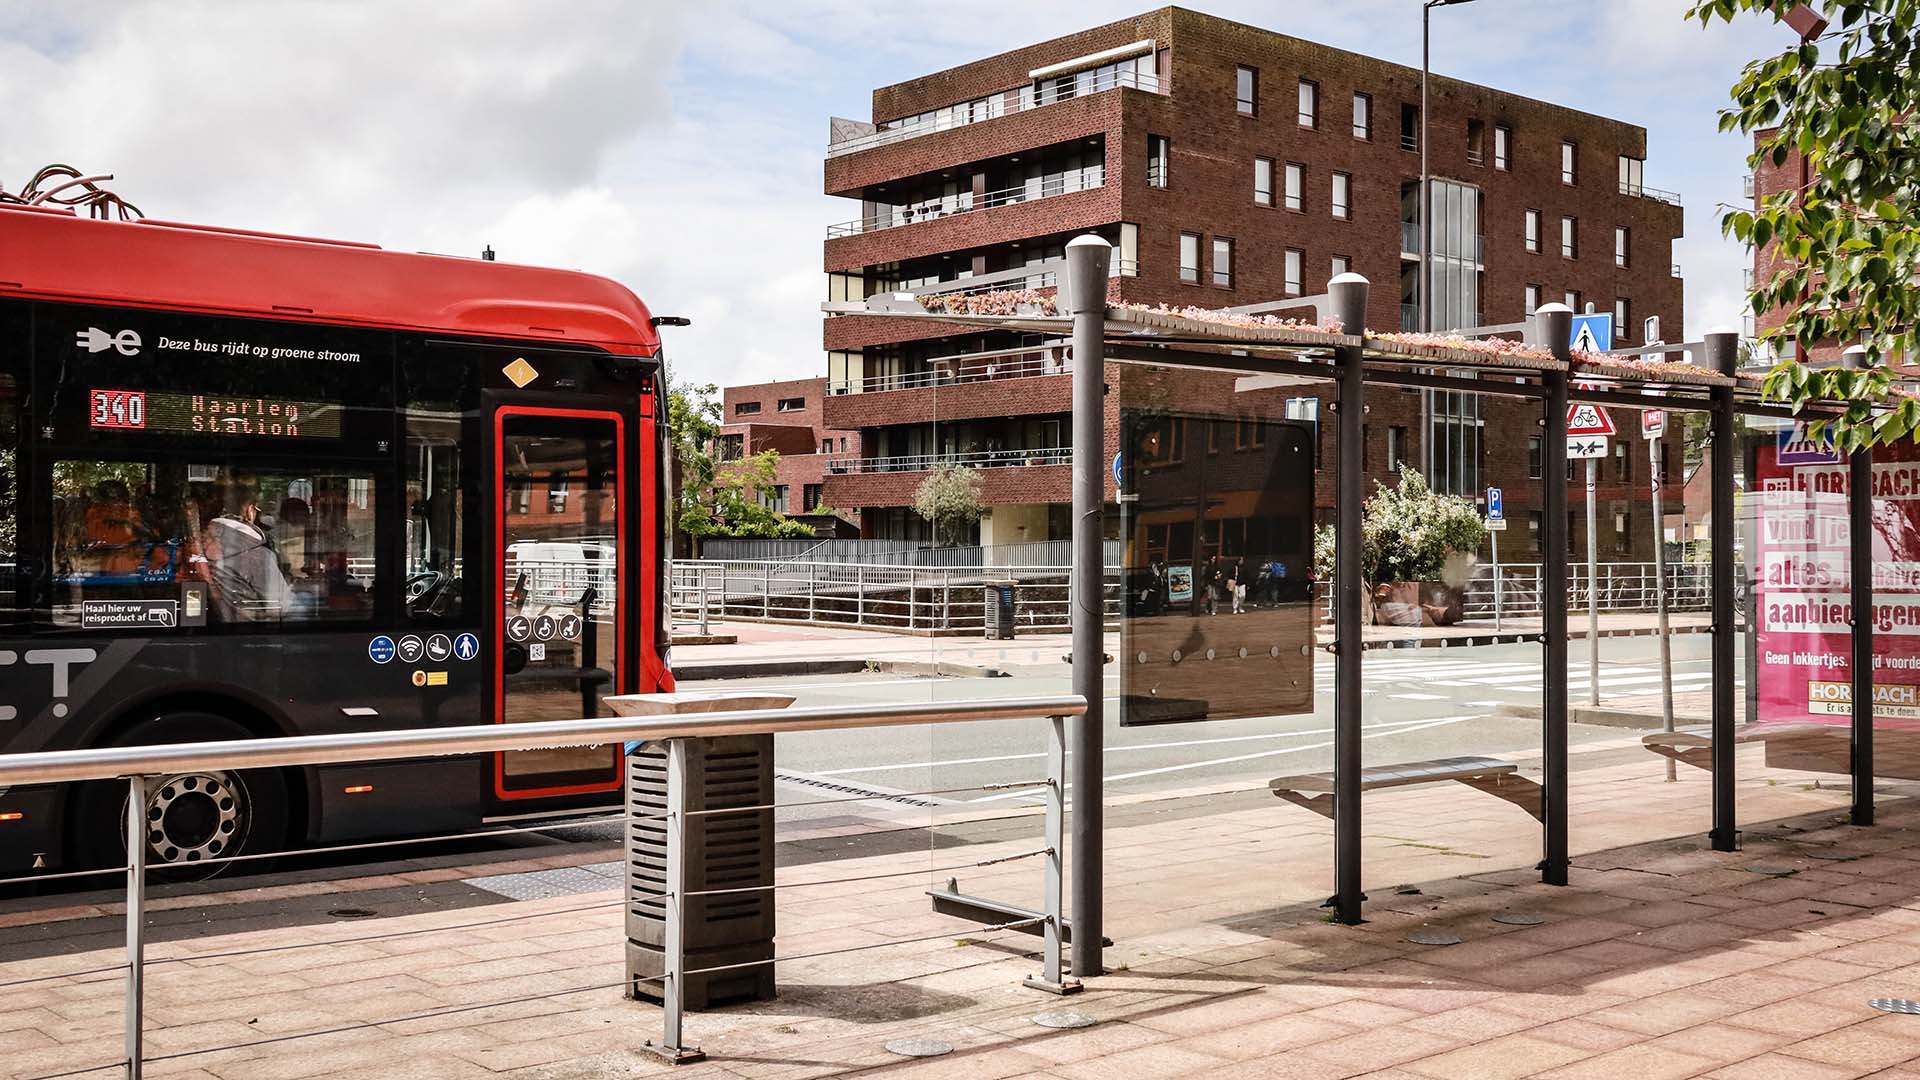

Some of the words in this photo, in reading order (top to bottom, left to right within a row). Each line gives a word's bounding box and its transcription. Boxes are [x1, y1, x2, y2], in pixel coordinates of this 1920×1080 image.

[158, 337, 191, 350] Deze
[194, 339, 218, 352] bus
[221, 343, 249, 355] rijdt
[252, 346, 269, 358] op
[271, 348, 315, 360] groene
[317, 350, 361, 363] stroom
[93, 394, 142, 424] 340
[191, 395, 298, 418] Haarlem
[191, 416, 298, 436] Station
[1767, 482, 1787, 502] Bij
[1797, 469, 1920, 498] HORACH
[1491, 491, 1499, 507] P
[1768, 513, 1816, 541] vind
[85, 605, 106, 613] Haal
[108, 605, 125, 613] hier
[85, 613, 135, 624] reisproduct
[137, 613, 147, 621] af
[1769, 597, 1920, 632] aanbiegen
[1765, 651, 1790, 665] Geen
[1793, 651, 1848, 670] lokkertjes.
[1811, 684, 1914, 704] HORACH
[1827, 704, 1834, 712] Er
[1838, 704, 1845, 712] is
